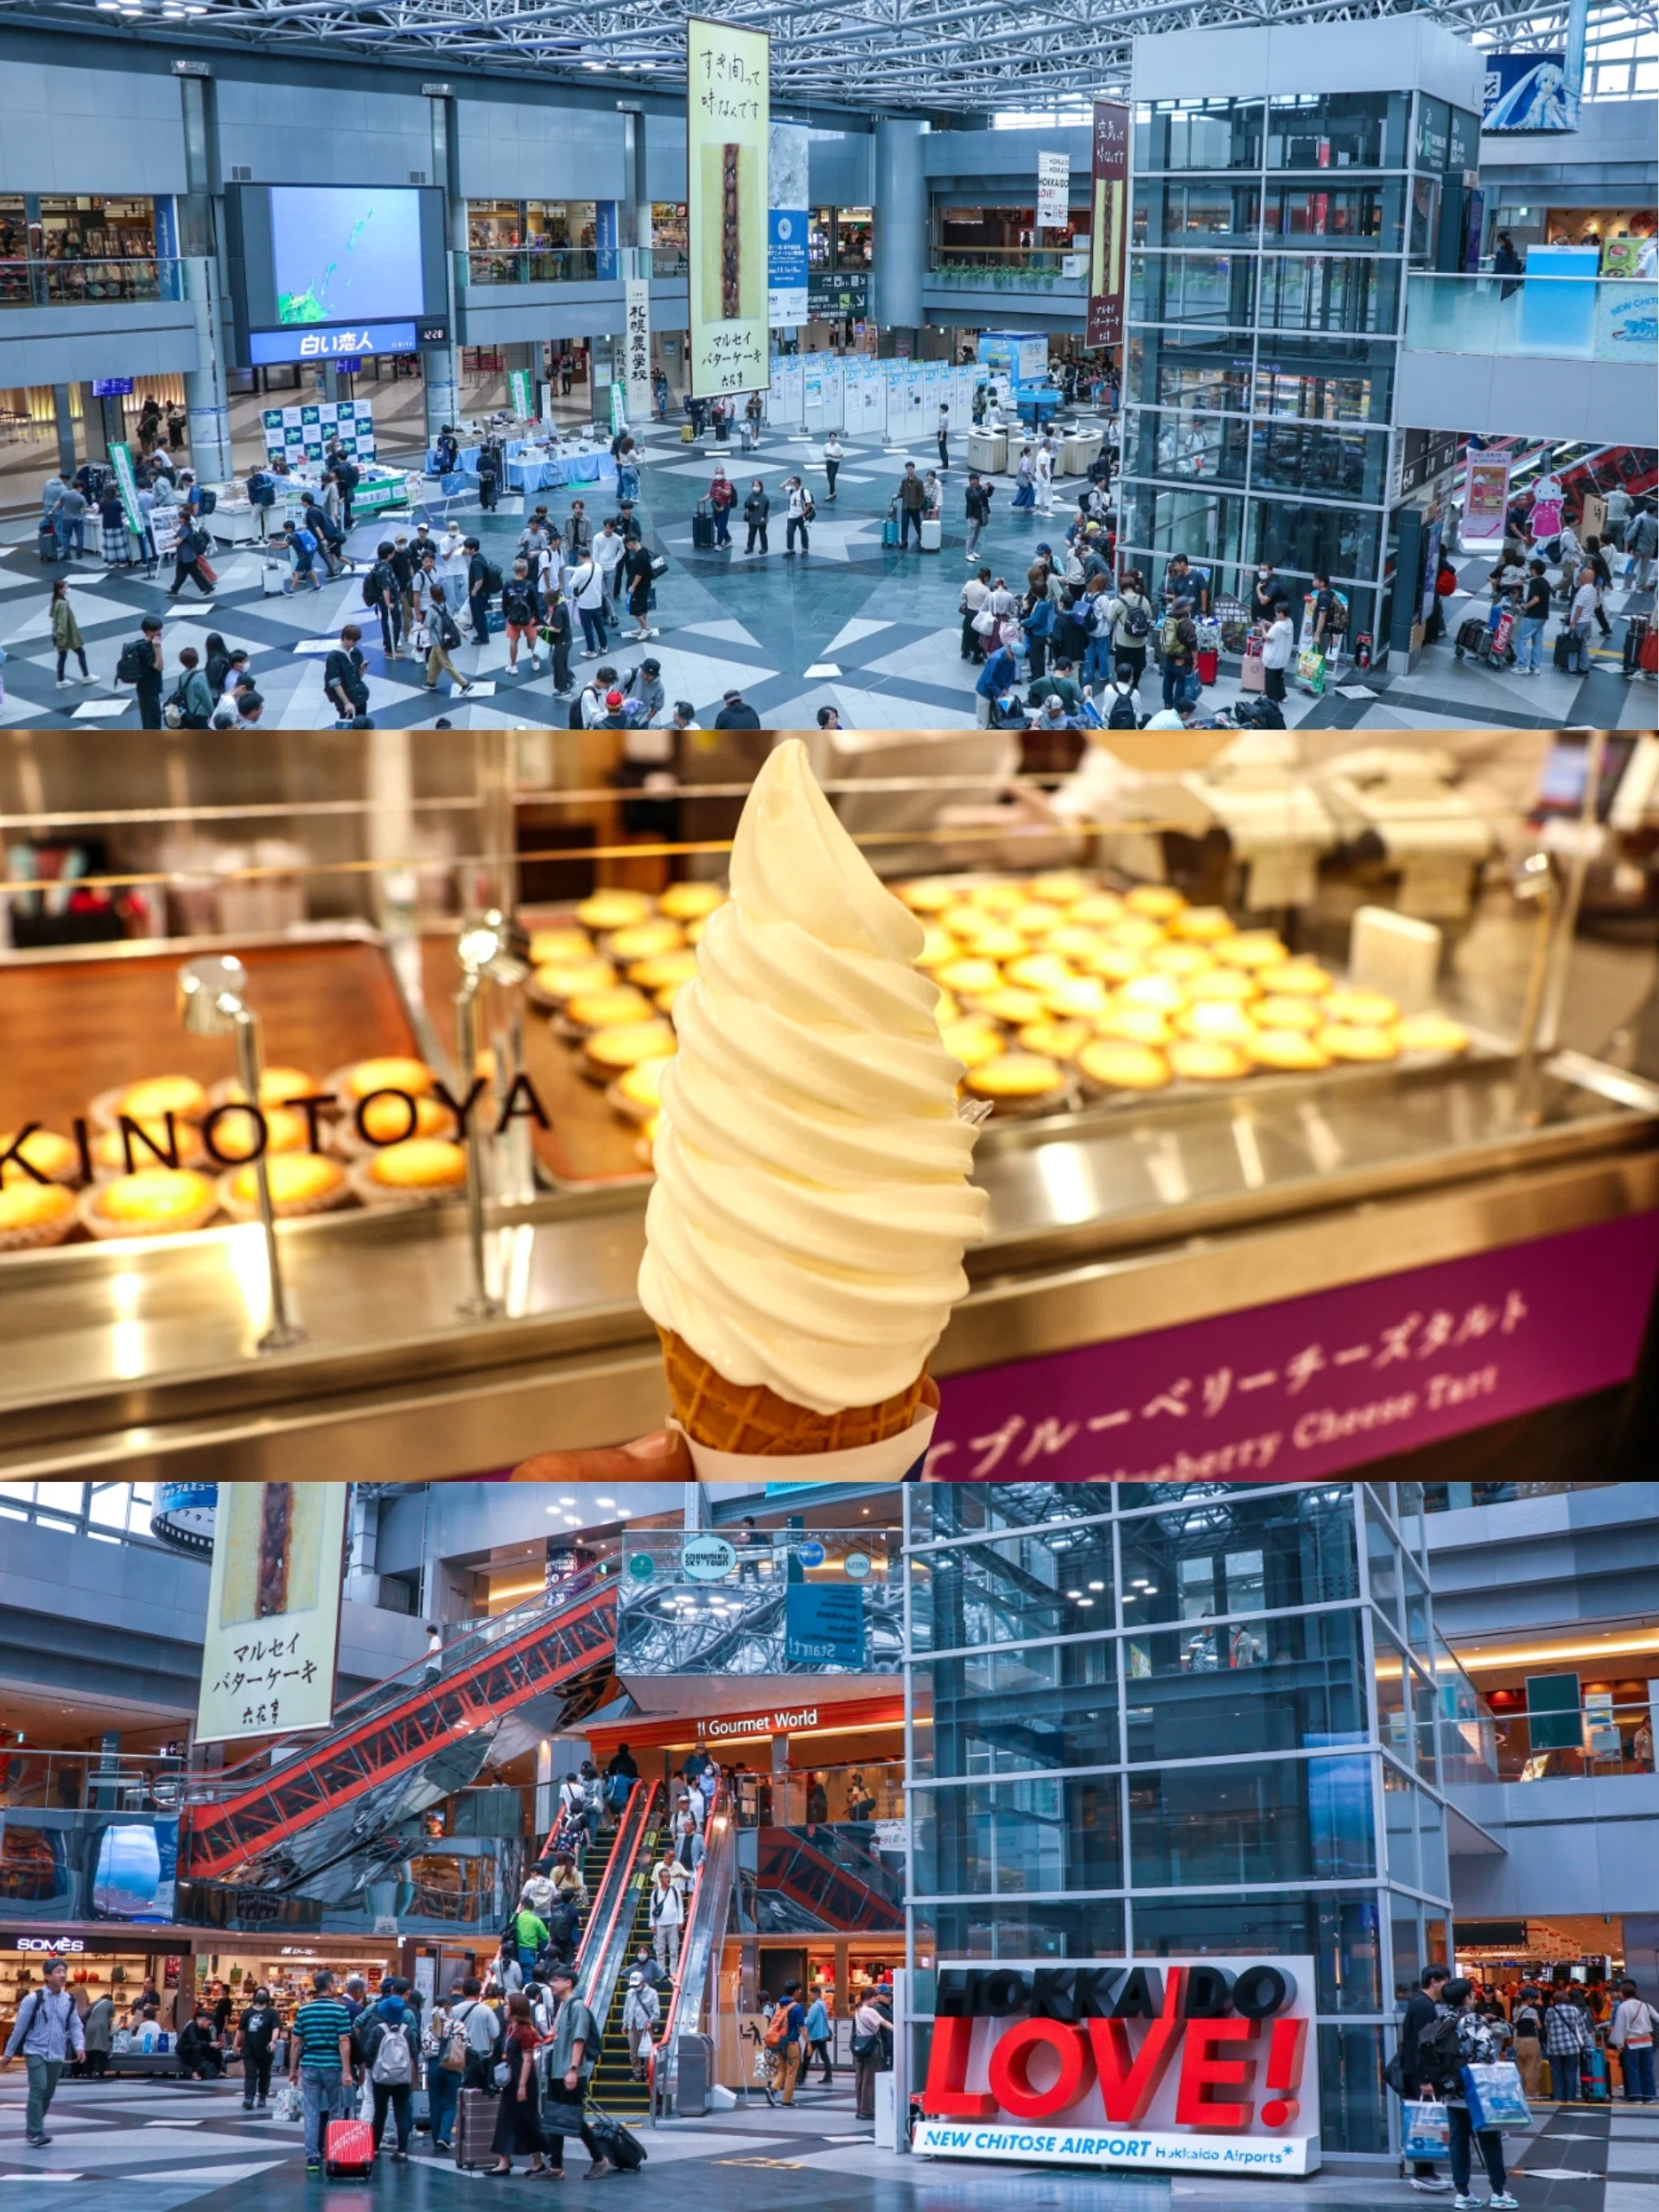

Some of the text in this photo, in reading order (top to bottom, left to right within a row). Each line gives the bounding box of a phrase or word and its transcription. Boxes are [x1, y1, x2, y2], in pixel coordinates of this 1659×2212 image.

[700, 49, 760, 86] すき間って
[702, 87, 760, 120] 味なんです
[1611, 296, 1657, 315] NEW CHIT
[300, 331, 373, 355] 白い恋人
[629, 305, 648, 382] 札幌農學校
[713, 331, 751, 347] マルセイ
[702, 348, 761, 367] バターケーキ
[0, 1071, 553, 1191] KINOTOYA
[1293, 1391, 1418, 1451] Cheese
[1425, 1364, 1499, 1411] Tart
[233, 1632, 300, 1663] マルセイ
[213, 1660, 317, 1696] バターケーキ
[242, 1698, 279, 1725] 六花亭
[709, 1708, 817, 1735] Gourmet World
[17, 1936, 84, 1952] SOMÈS
[934, 1965, 1298, 2019] HOKKAIDO
[924, 2017, 1309, 2127] LOVE!
[924, 2130, 1283, 2165] NEW CHITOSE AIRPORT Hokkaido Airports
